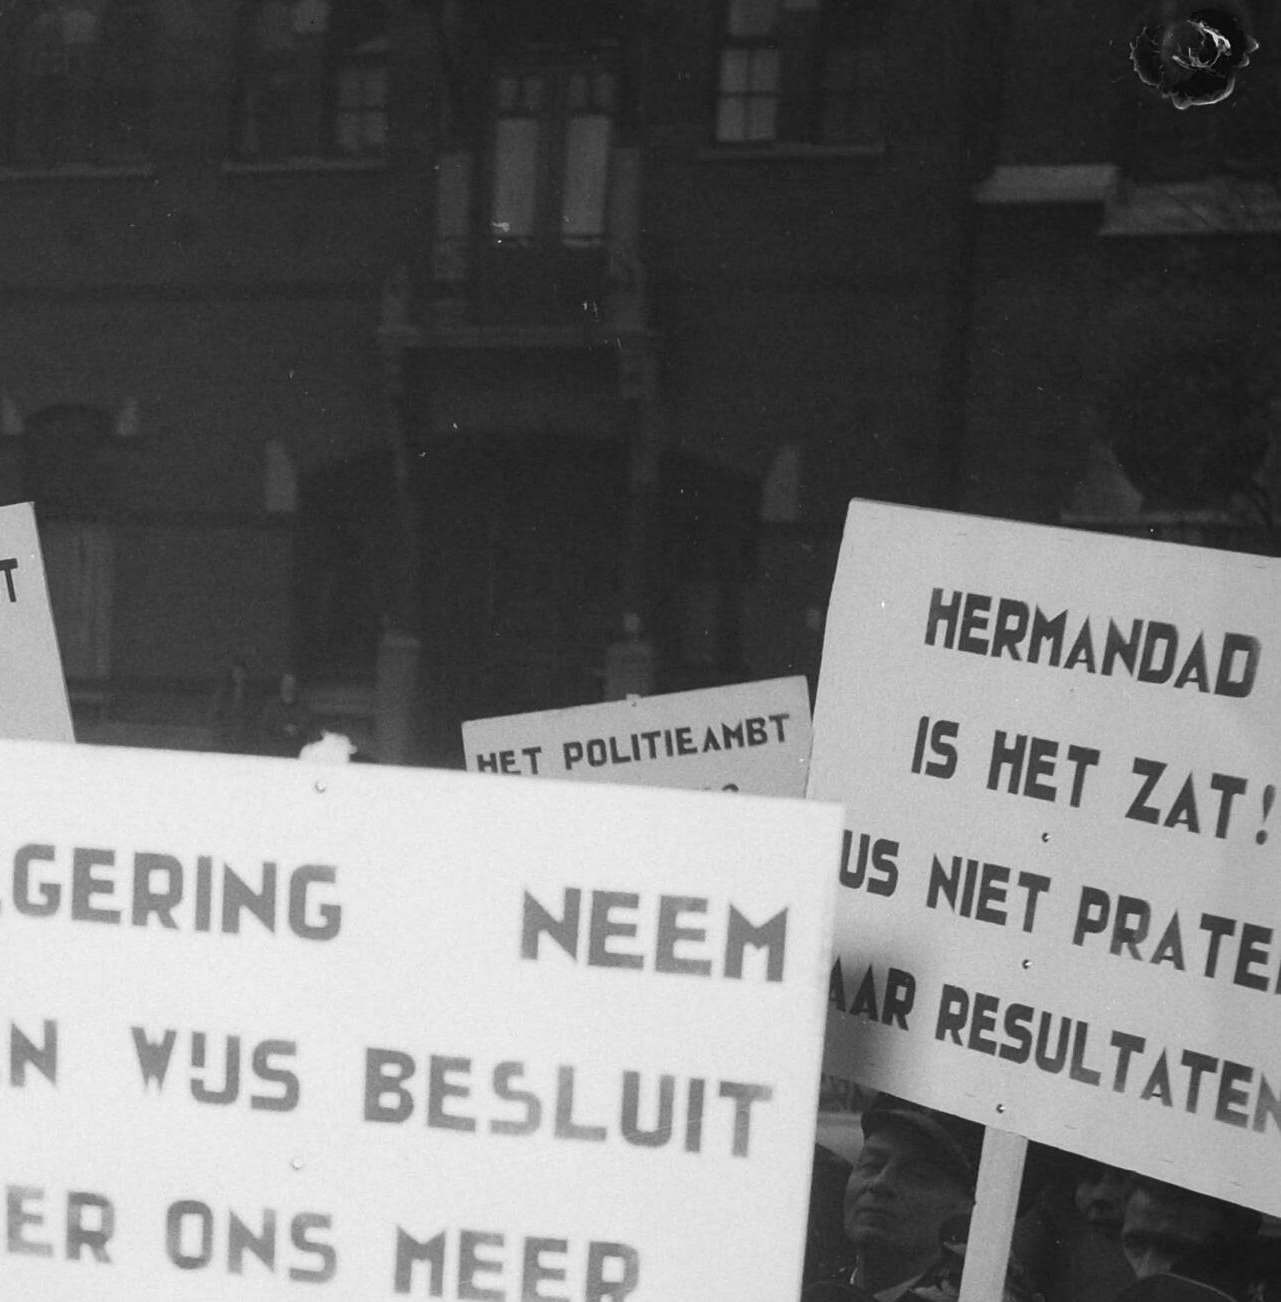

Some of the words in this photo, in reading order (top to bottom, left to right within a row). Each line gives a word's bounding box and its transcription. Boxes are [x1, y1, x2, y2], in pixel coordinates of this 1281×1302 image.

[925, 589, 1260, 698] HERMANDAD
[477, 747, 541, 774] HET
[563, 714, 789, 770] POLITIEAMBT
[912, 716, 959, 779] IS
[987, 730, 1100, 807] HET
[1126, 757, 1275, 845] ZAT!
[520, 887, 789, 983] NEEM
[840, 830, 899, 897] US
[927, 856, 1050, 932] NIET
[1073, 886, 1281, 994] PRATE
[131, 1027, 300, 1112] WIJS
[364, 1047, 773, 1158] BESLUIT
[828, 957, 916, 1031] AAR
[935, 983, 1281, 1134] RESULTATEN
[166, 1200, 336, 1284] ONS
